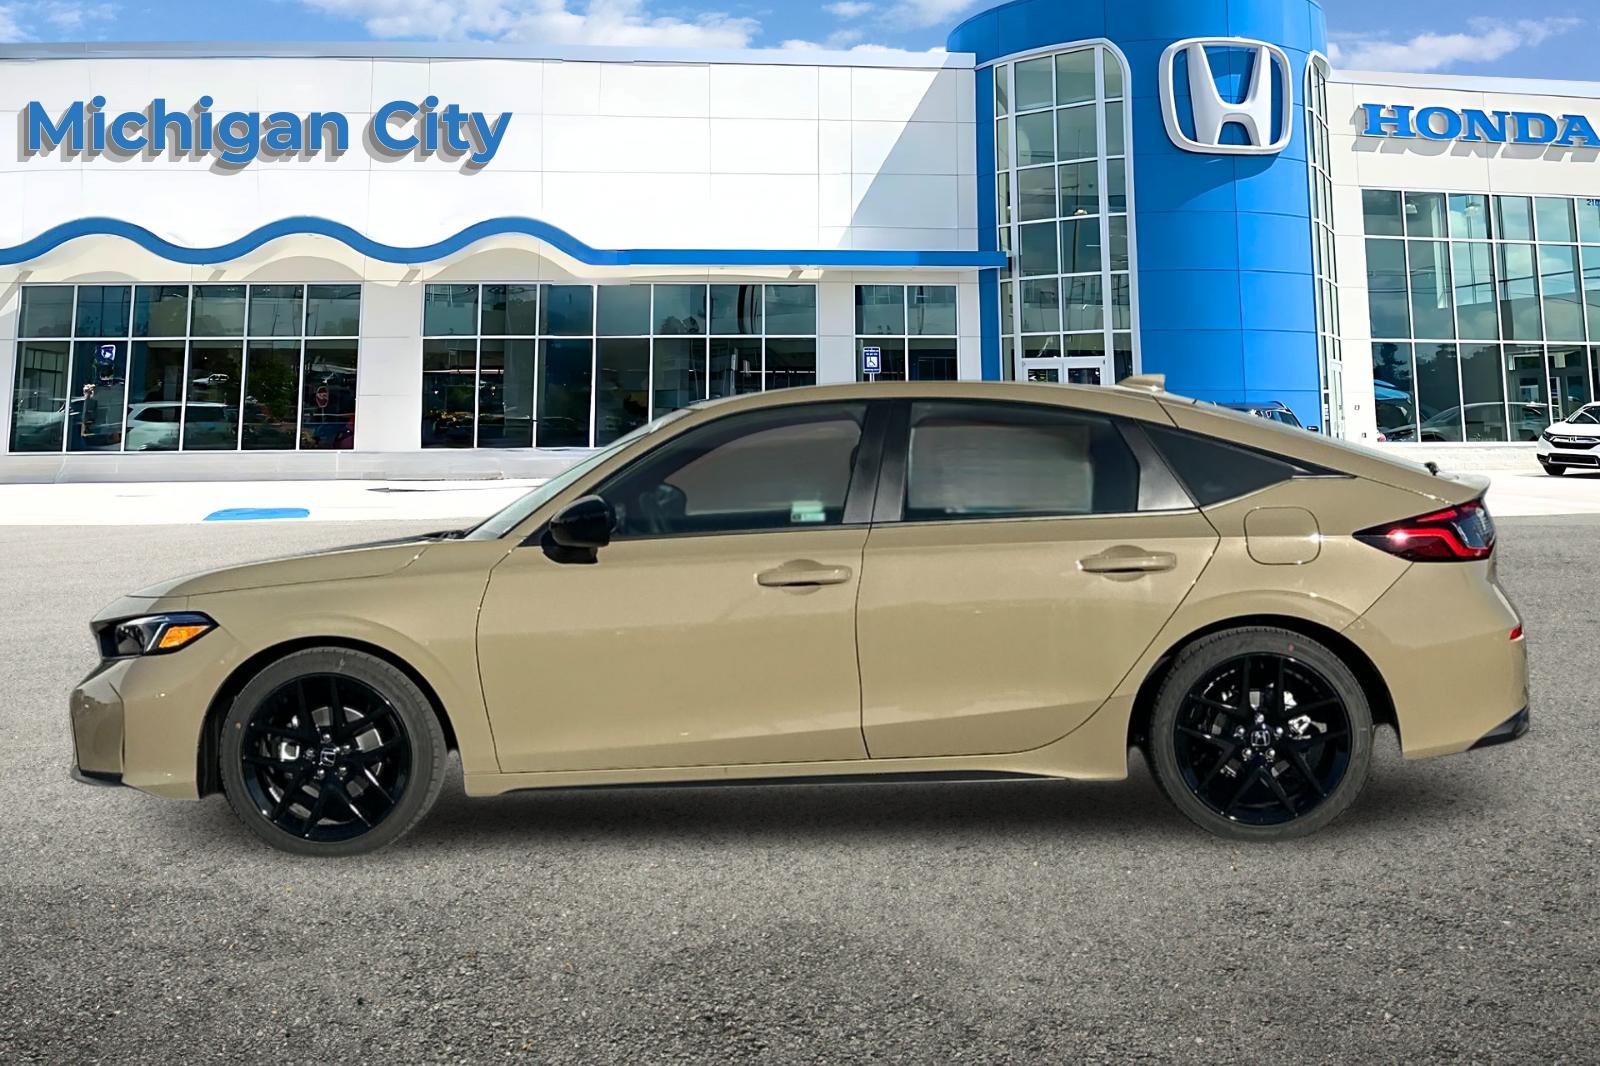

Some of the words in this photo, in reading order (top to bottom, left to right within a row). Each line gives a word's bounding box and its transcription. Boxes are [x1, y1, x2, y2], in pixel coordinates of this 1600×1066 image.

[28, 95, 349, 164] Michigan
[373, 95, 513, 164] City
[1361, 103, 1600, 147] HONDA
